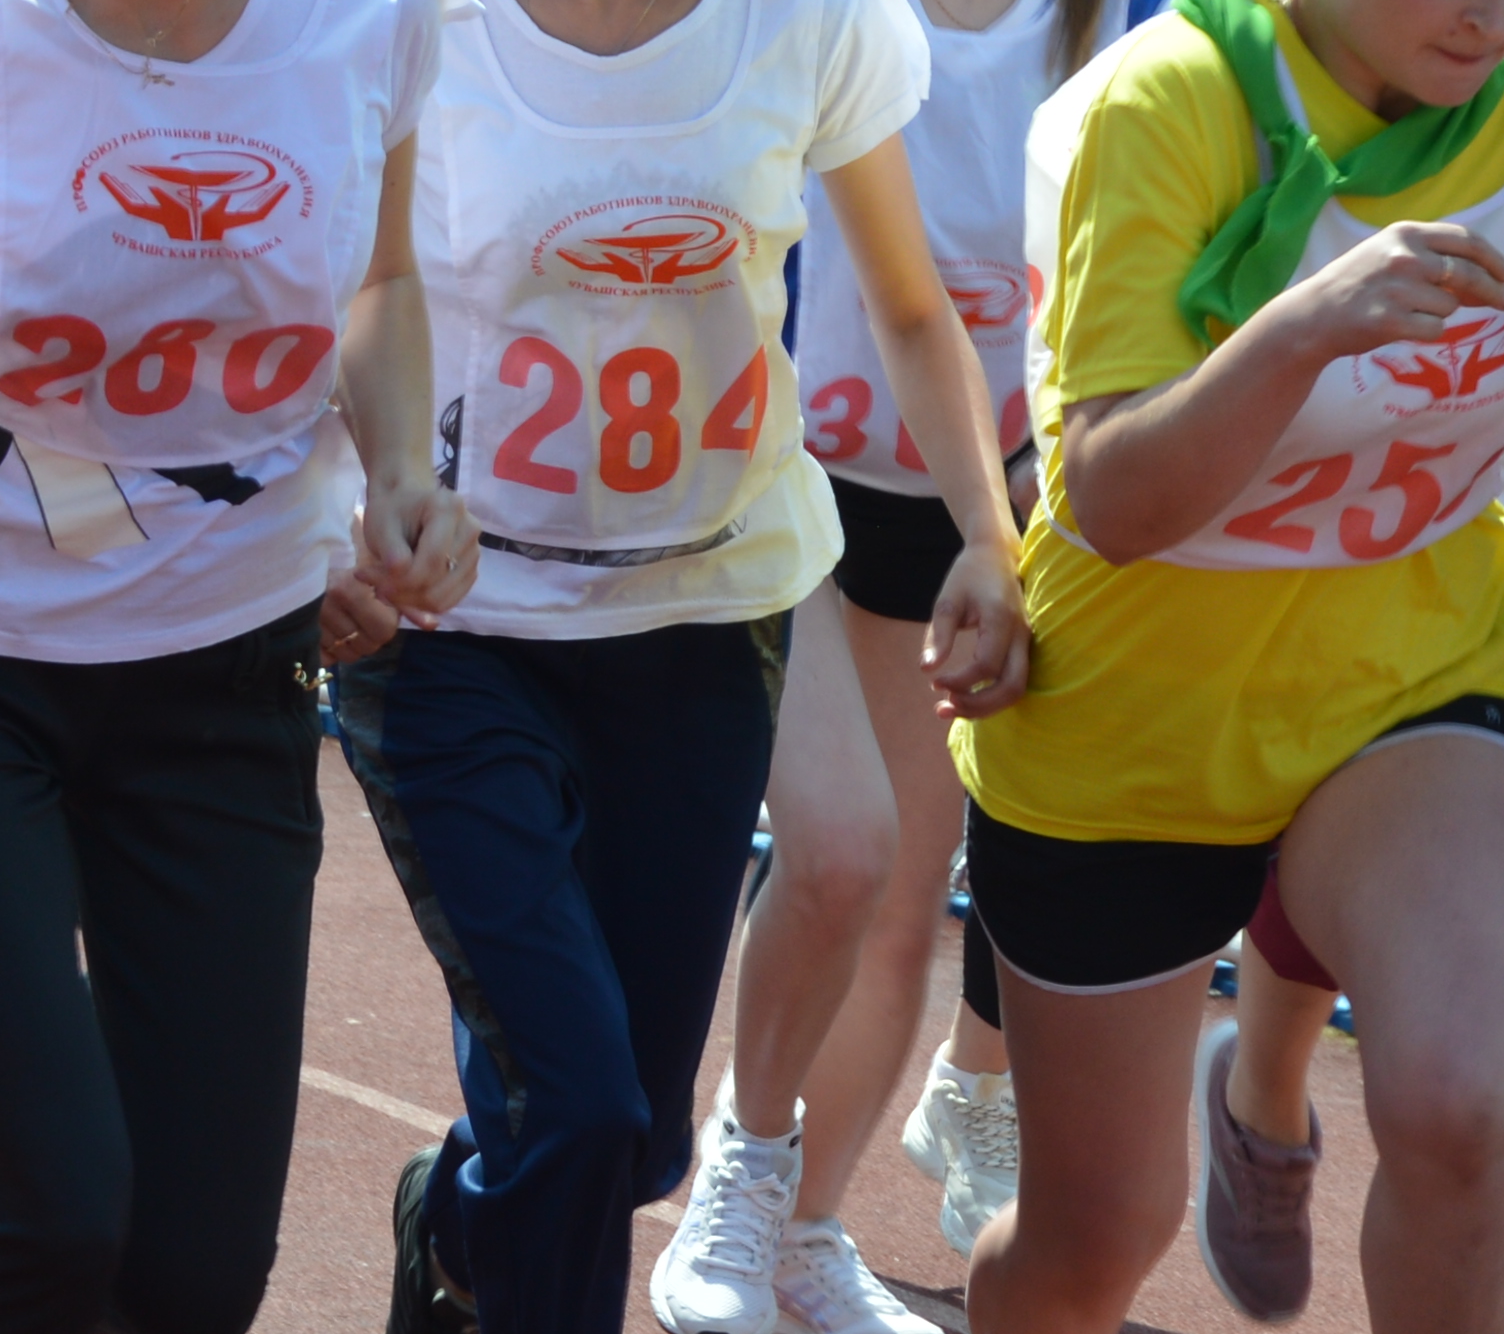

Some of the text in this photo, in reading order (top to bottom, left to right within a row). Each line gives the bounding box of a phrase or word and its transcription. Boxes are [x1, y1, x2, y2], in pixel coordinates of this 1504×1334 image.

[121, 126, 212, 145] РАБОТНИКОВ
[216, 130, 314, 219] ЗДРАВООХРАНЕНИЯ
[112, 231, 197, 260] ЧУВАШСКАЯ
[531, 216, 574, 277] ПРОФСОЮЗ
[574, 195, 664, 220] РАБОТНИКОВ
[568, 279, 647, 297] ЧУВАШСКАЯ
[493, 336, 769, 495] 284
